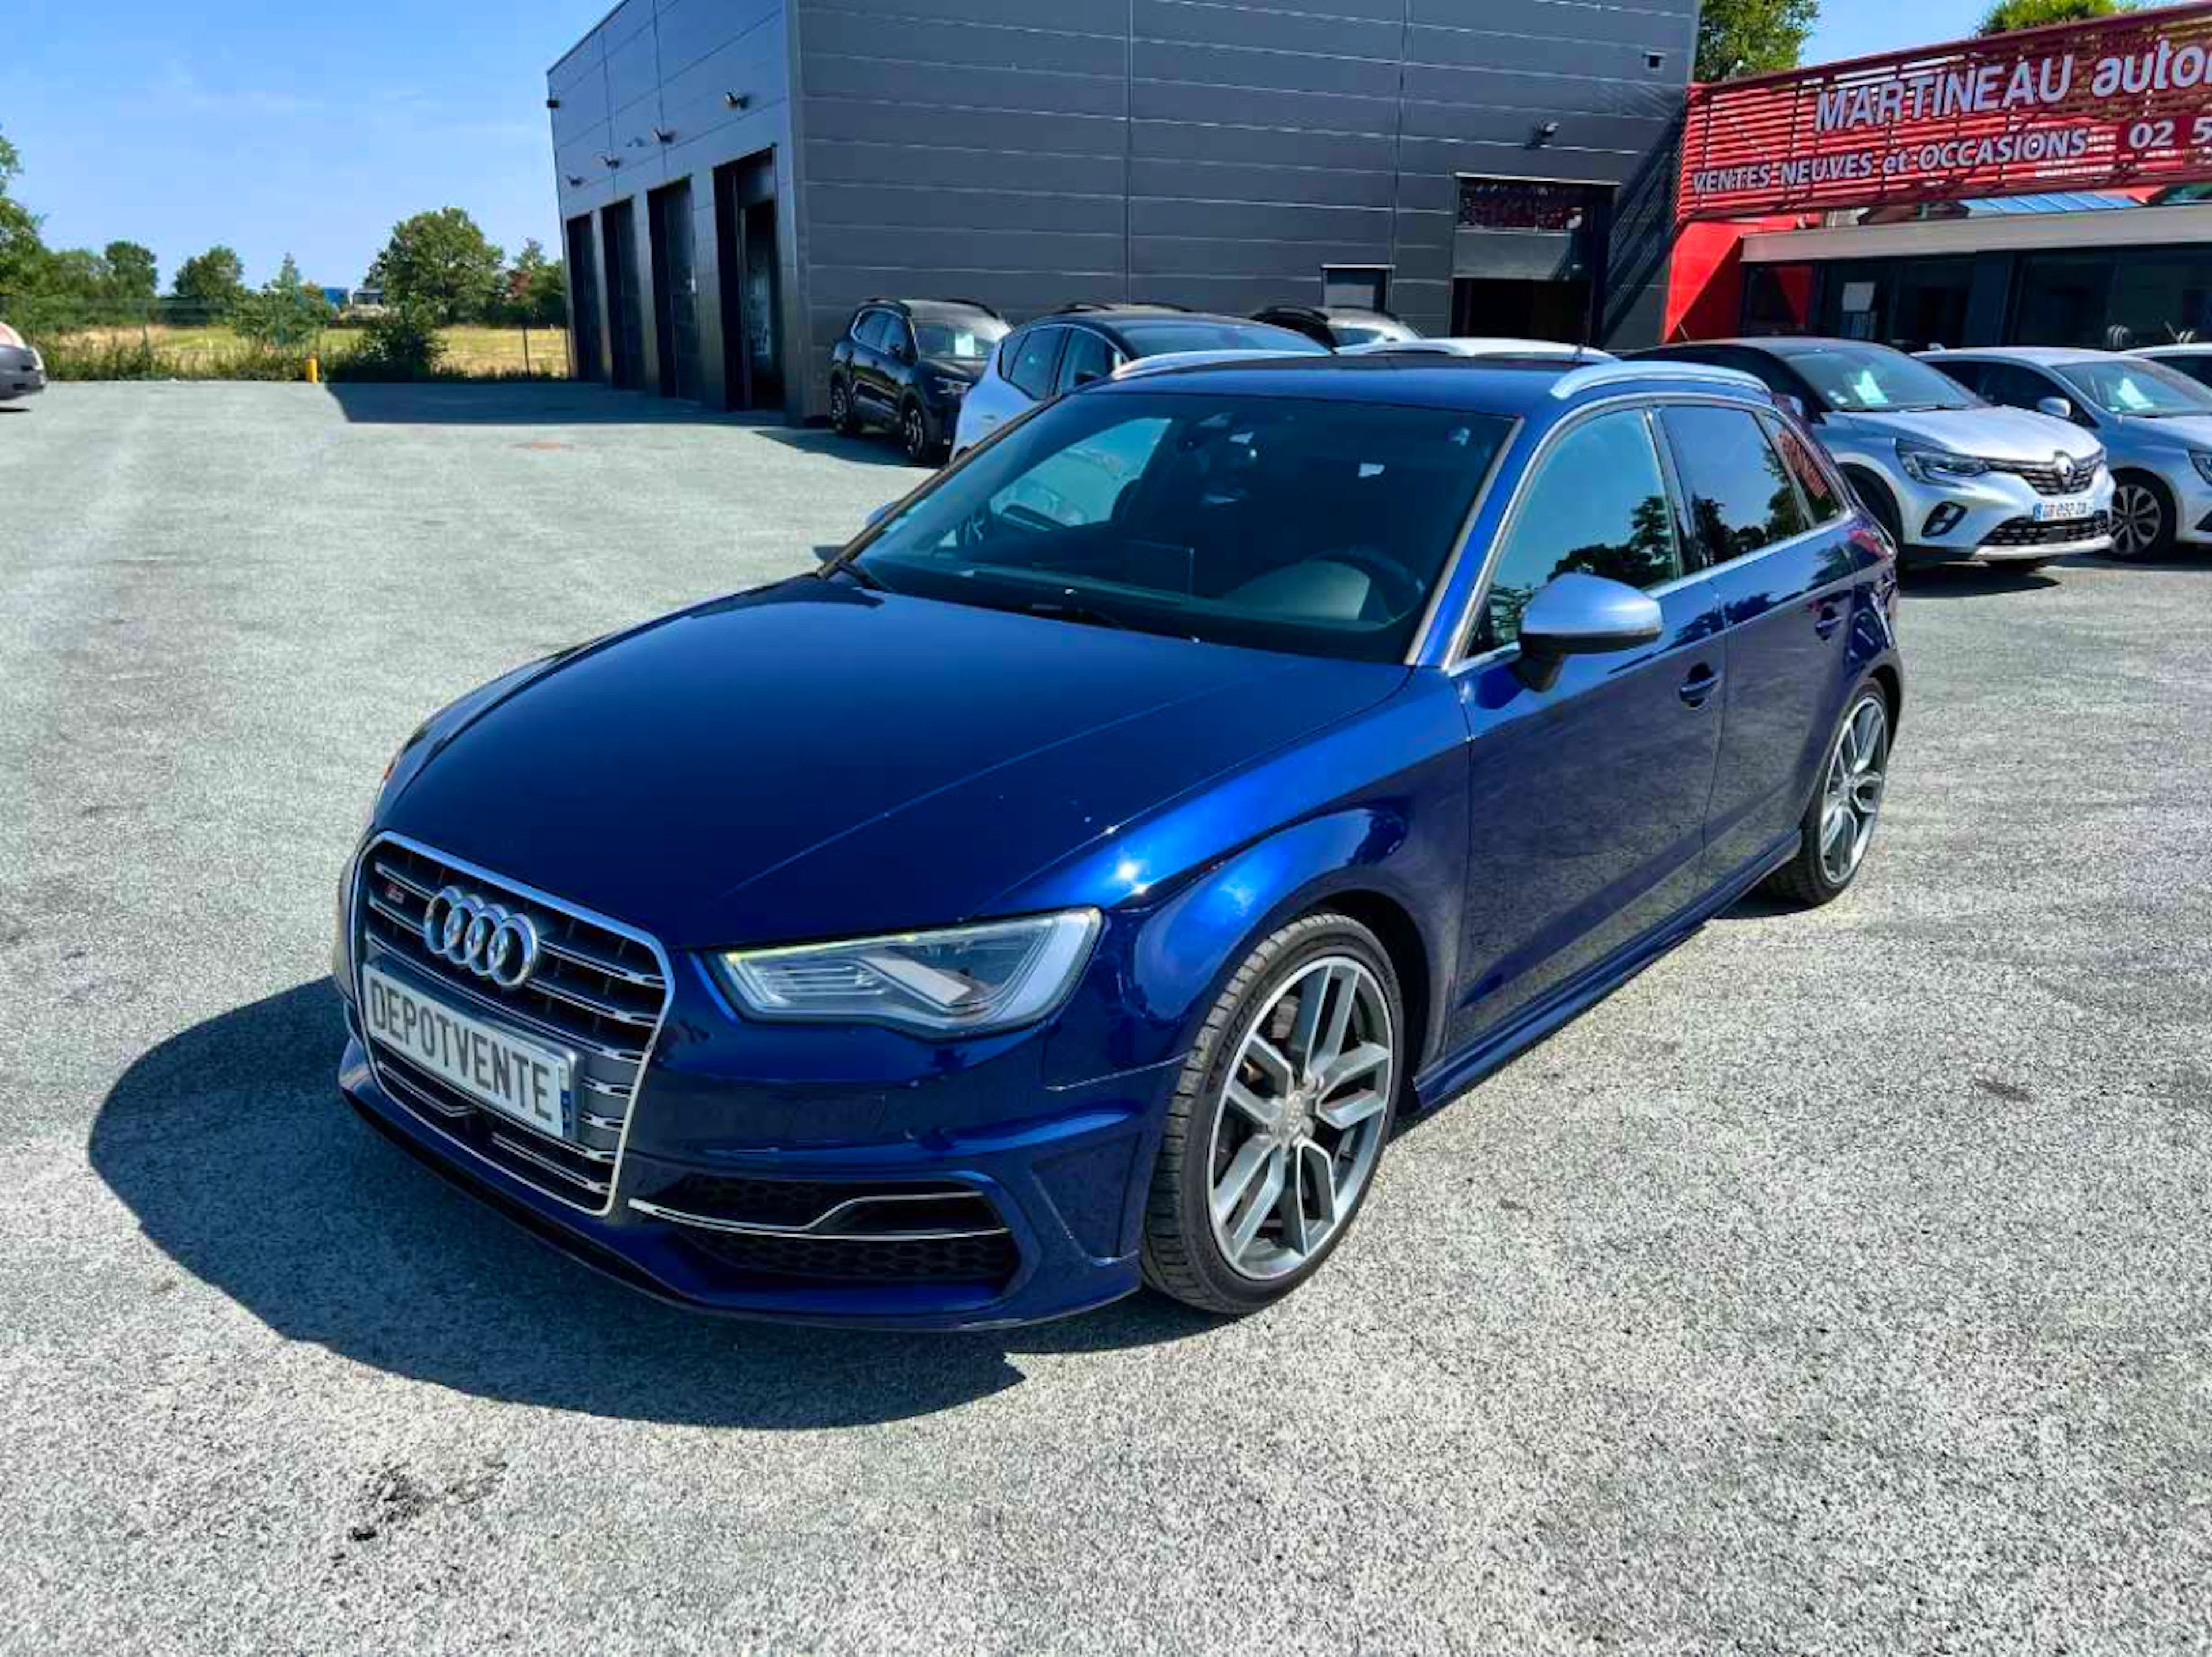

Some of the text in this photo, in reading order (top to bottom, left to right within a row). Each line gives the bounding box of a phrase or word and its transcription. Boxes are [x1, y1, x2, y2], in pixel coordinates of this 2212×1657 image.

[1815, 39, 2212, 132] MARTINEAU auto
[1692, 128, 2088, 194] VENTES NEUVES et OCCASIONS
[2128, 120, 2175, 150] 02
[370, 976, 553, 1123] DEPOTVENTE
